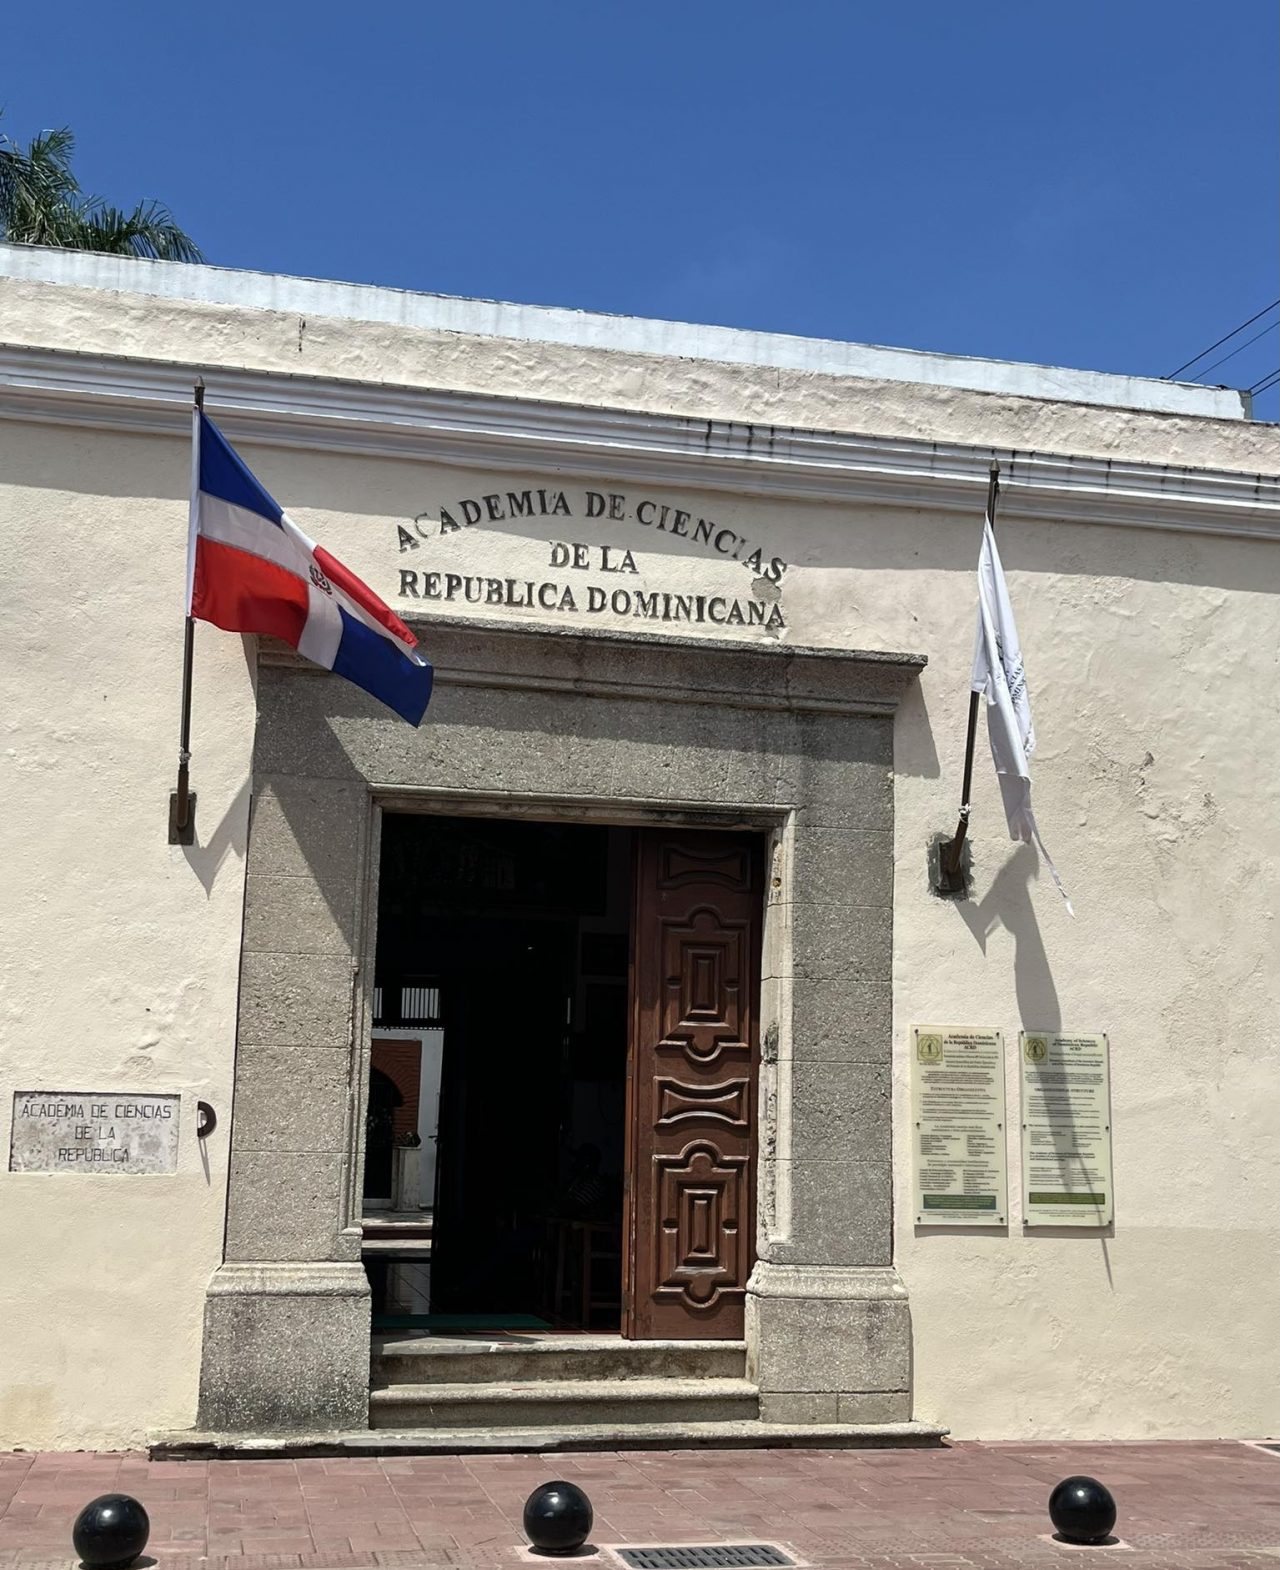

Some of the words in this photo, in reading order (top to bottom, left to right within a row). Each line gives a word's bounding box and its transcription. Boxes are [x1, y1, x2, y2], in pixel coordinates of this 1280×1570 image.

[397, 489, 571, 553] ACADEMIA
[585, 491, 626, 521] DE
[636, 501, 787, 584] CIENCIAS
[548, 541, 590, 570] DE
[600, 546, 640, 574] LA
[398, 569, 579, 612] REPUBLICA
[586, 586, 786, 628] DOMINICANA
[22, 1104, 85, 1118] ACADEMIA
[91, 1104, 109, 1119] DE
[115, 1104, 172, 1119] CIENCIAS
[75, 1126, 91, 1140] DE
[99, 1126, 116, 1140] LA
[58, 1147, 130, 1163] REPUBLICA
